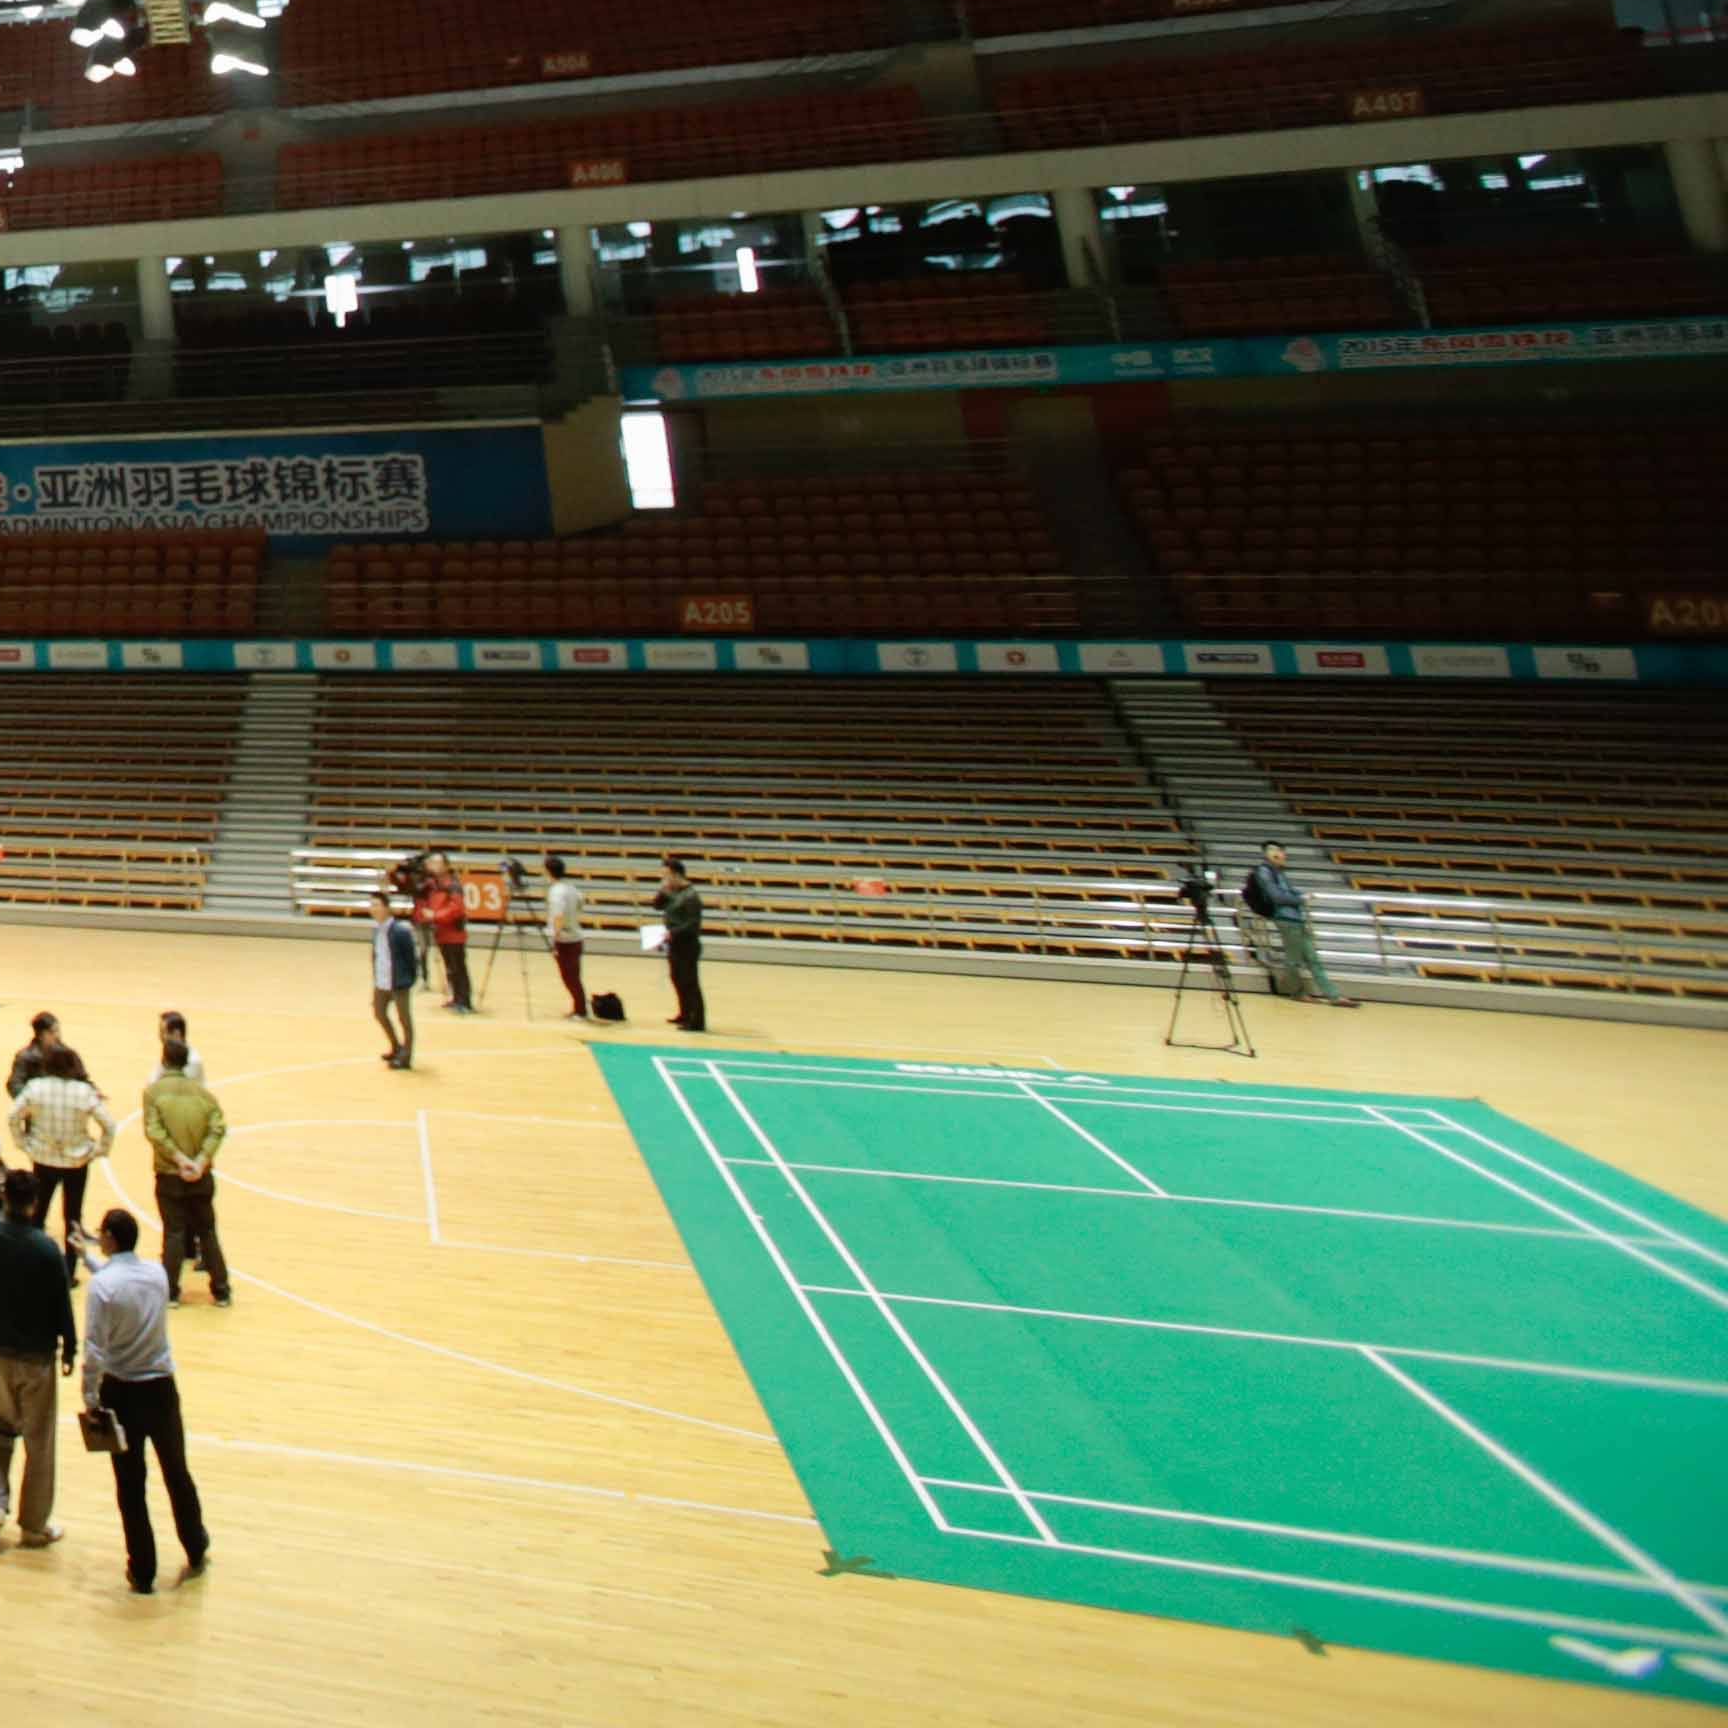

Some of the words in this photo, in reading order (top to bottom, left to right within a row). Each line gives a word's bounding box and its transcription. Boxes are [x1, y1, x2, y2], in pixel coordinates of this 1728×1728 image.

[1353, 91, 1417, 116] A407
[143, 513, 199, 530] ASIA
[204, 508, 425, 530] CHAMPIONSHIPS
[684, 601, 750, 625] A205
[1652, 598, 1728, 625] A20
[464, 883, 502, 911] 03
